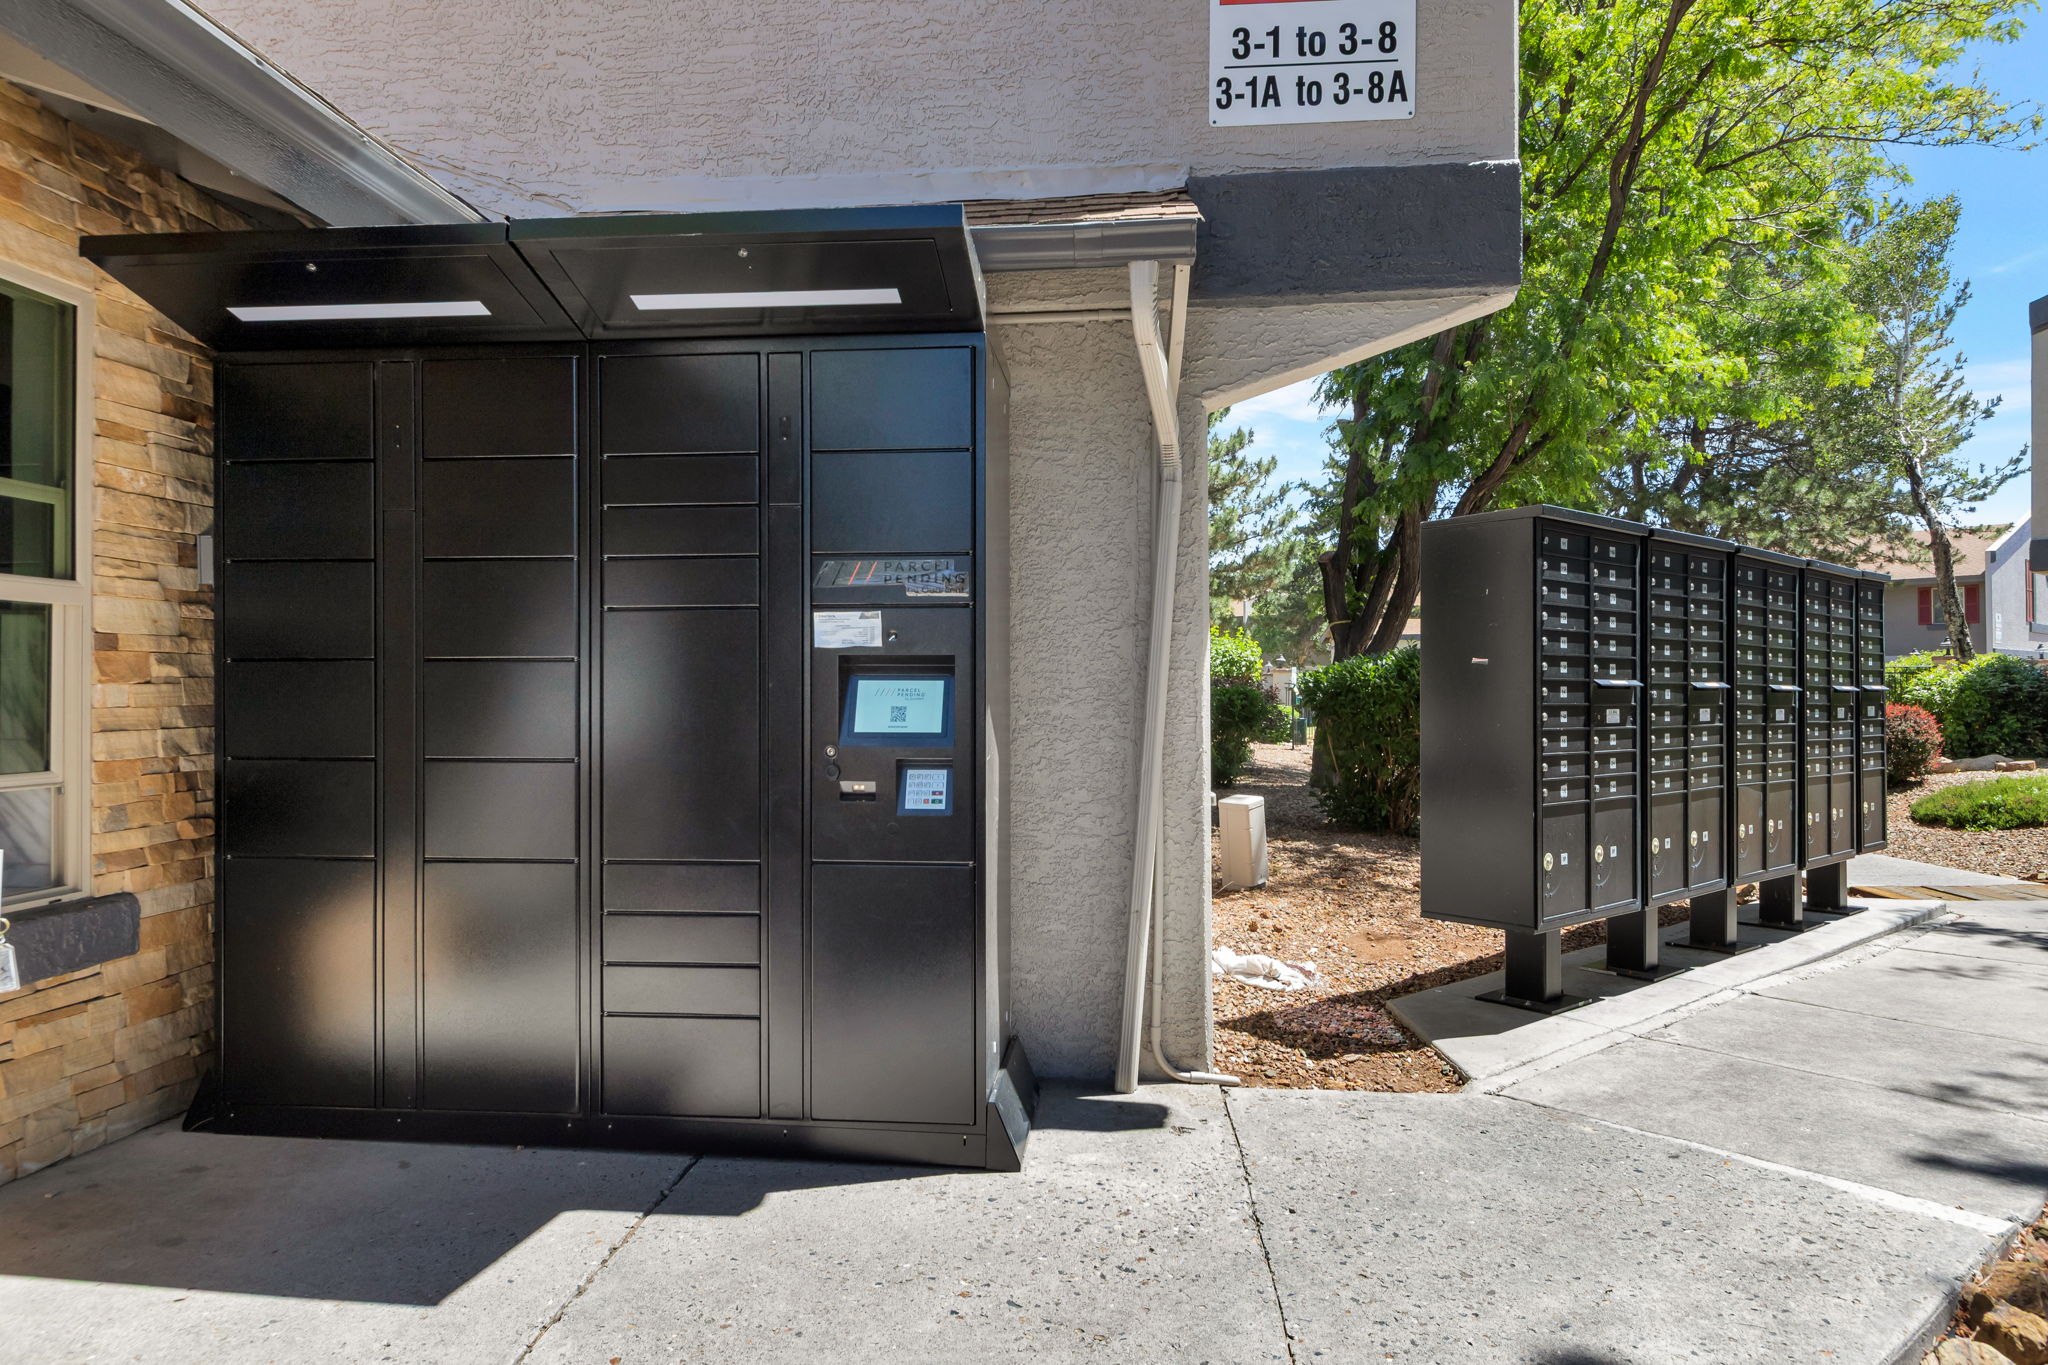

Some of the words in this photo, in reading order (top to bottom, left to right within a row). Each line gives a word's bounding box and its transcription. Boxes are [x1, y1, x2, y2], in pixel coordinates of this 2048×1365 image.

[1232, 26, 1280, 59] 3-1
[1296, 26, 1326, 57] to
[1338, 21, 1397, 56] 3-8
[1216, 75, 1281, 110] 3-1A
[1296, 76, 1322, 106] to
[1333, 70, 1408, 105] 3-8A
[883, 573, 966, 584] PENDING
